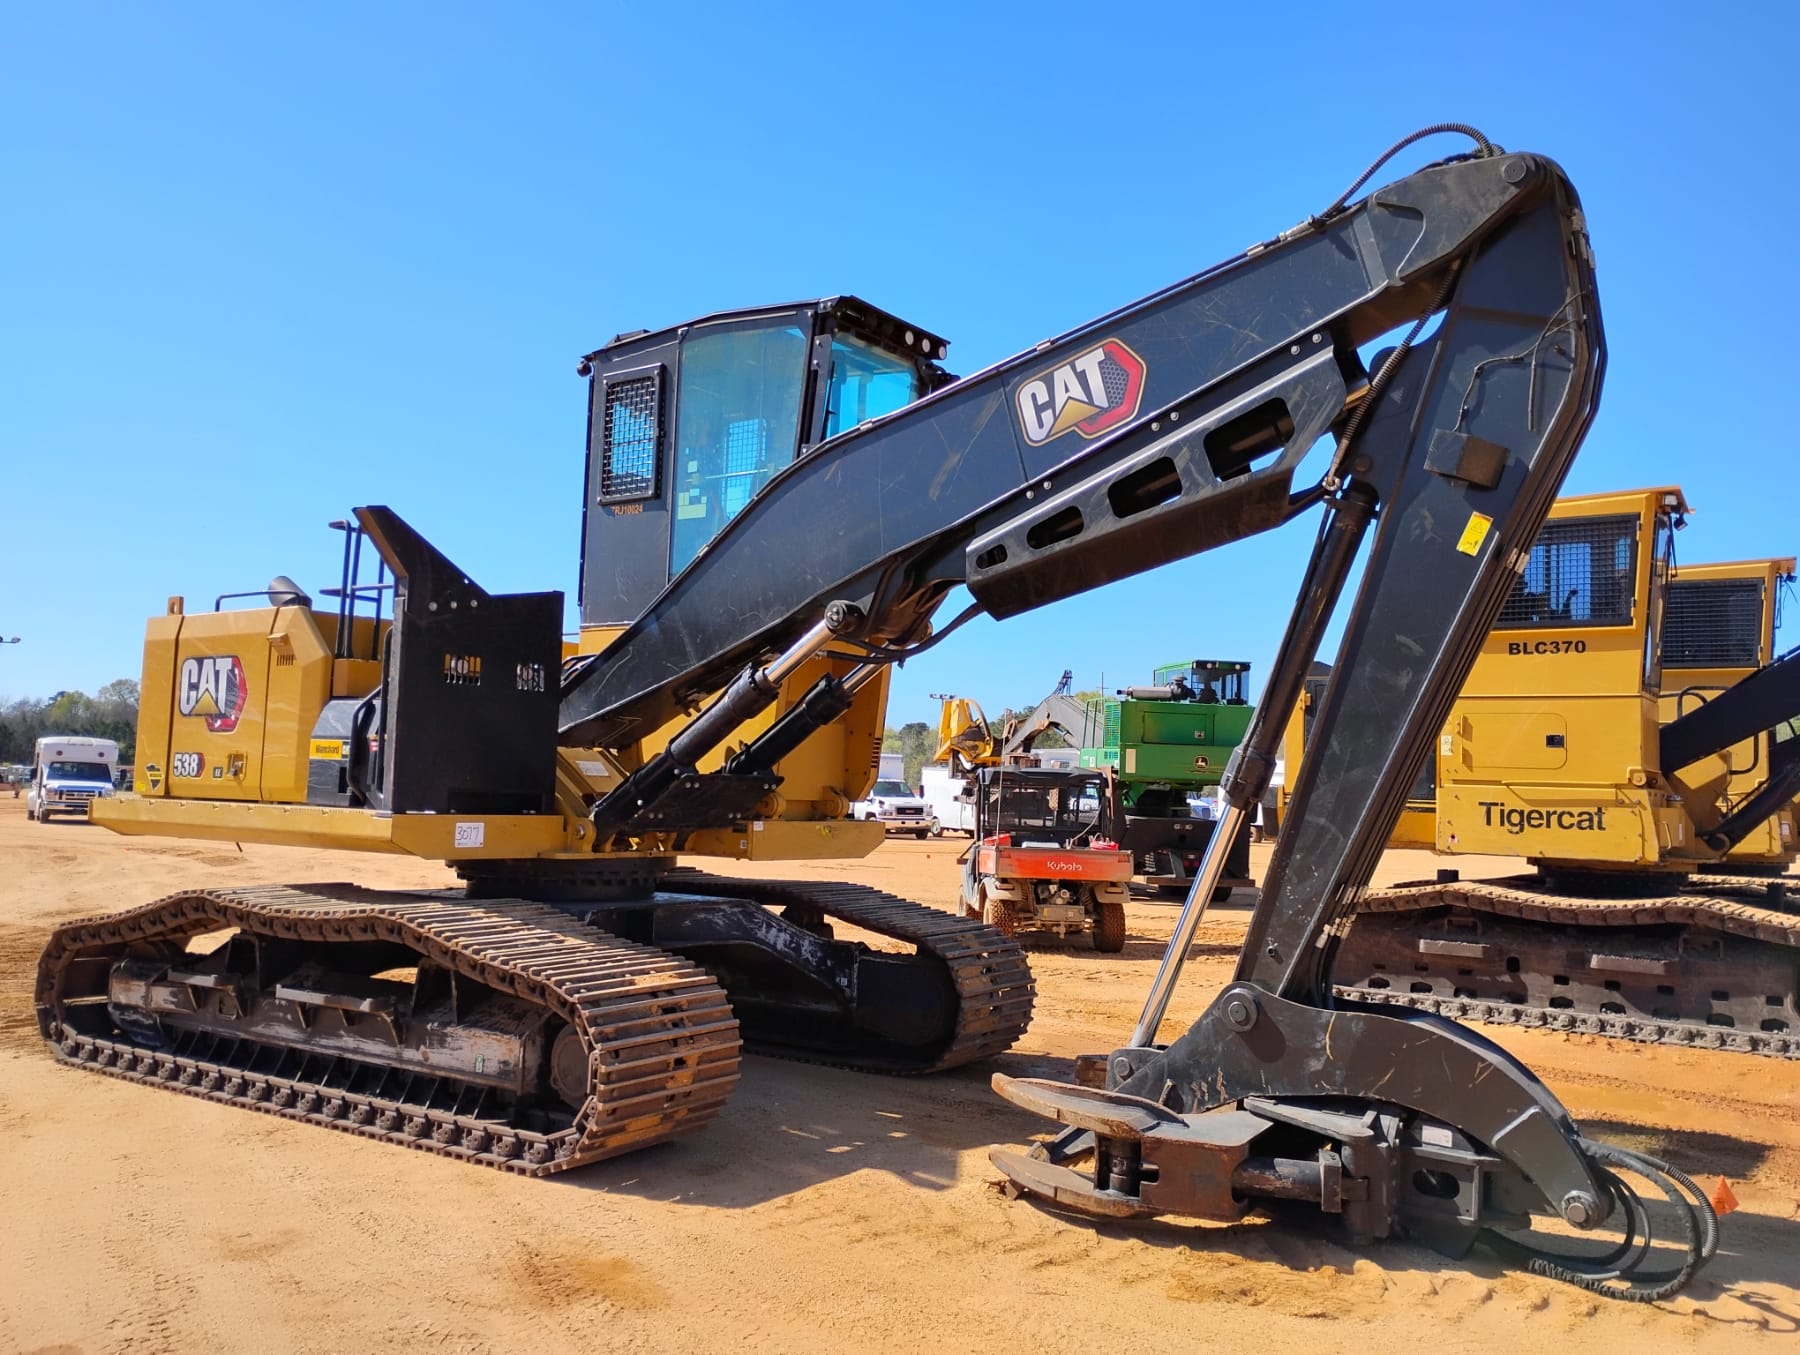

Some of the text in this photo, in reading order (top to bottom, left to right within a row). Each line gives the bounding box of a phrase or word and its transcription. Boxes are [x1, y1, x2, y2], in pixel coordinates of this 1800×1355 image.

[1019, 347, 1109, 441] CAT
[1508, 640, 1586, 656] BLC370
[180, 657, 233, 715] CAT
[173, 753, 200, 777] 538
[1478, 801, 1607, 835] Tigercat
[1047, 861, 1083, 872] Kubota
